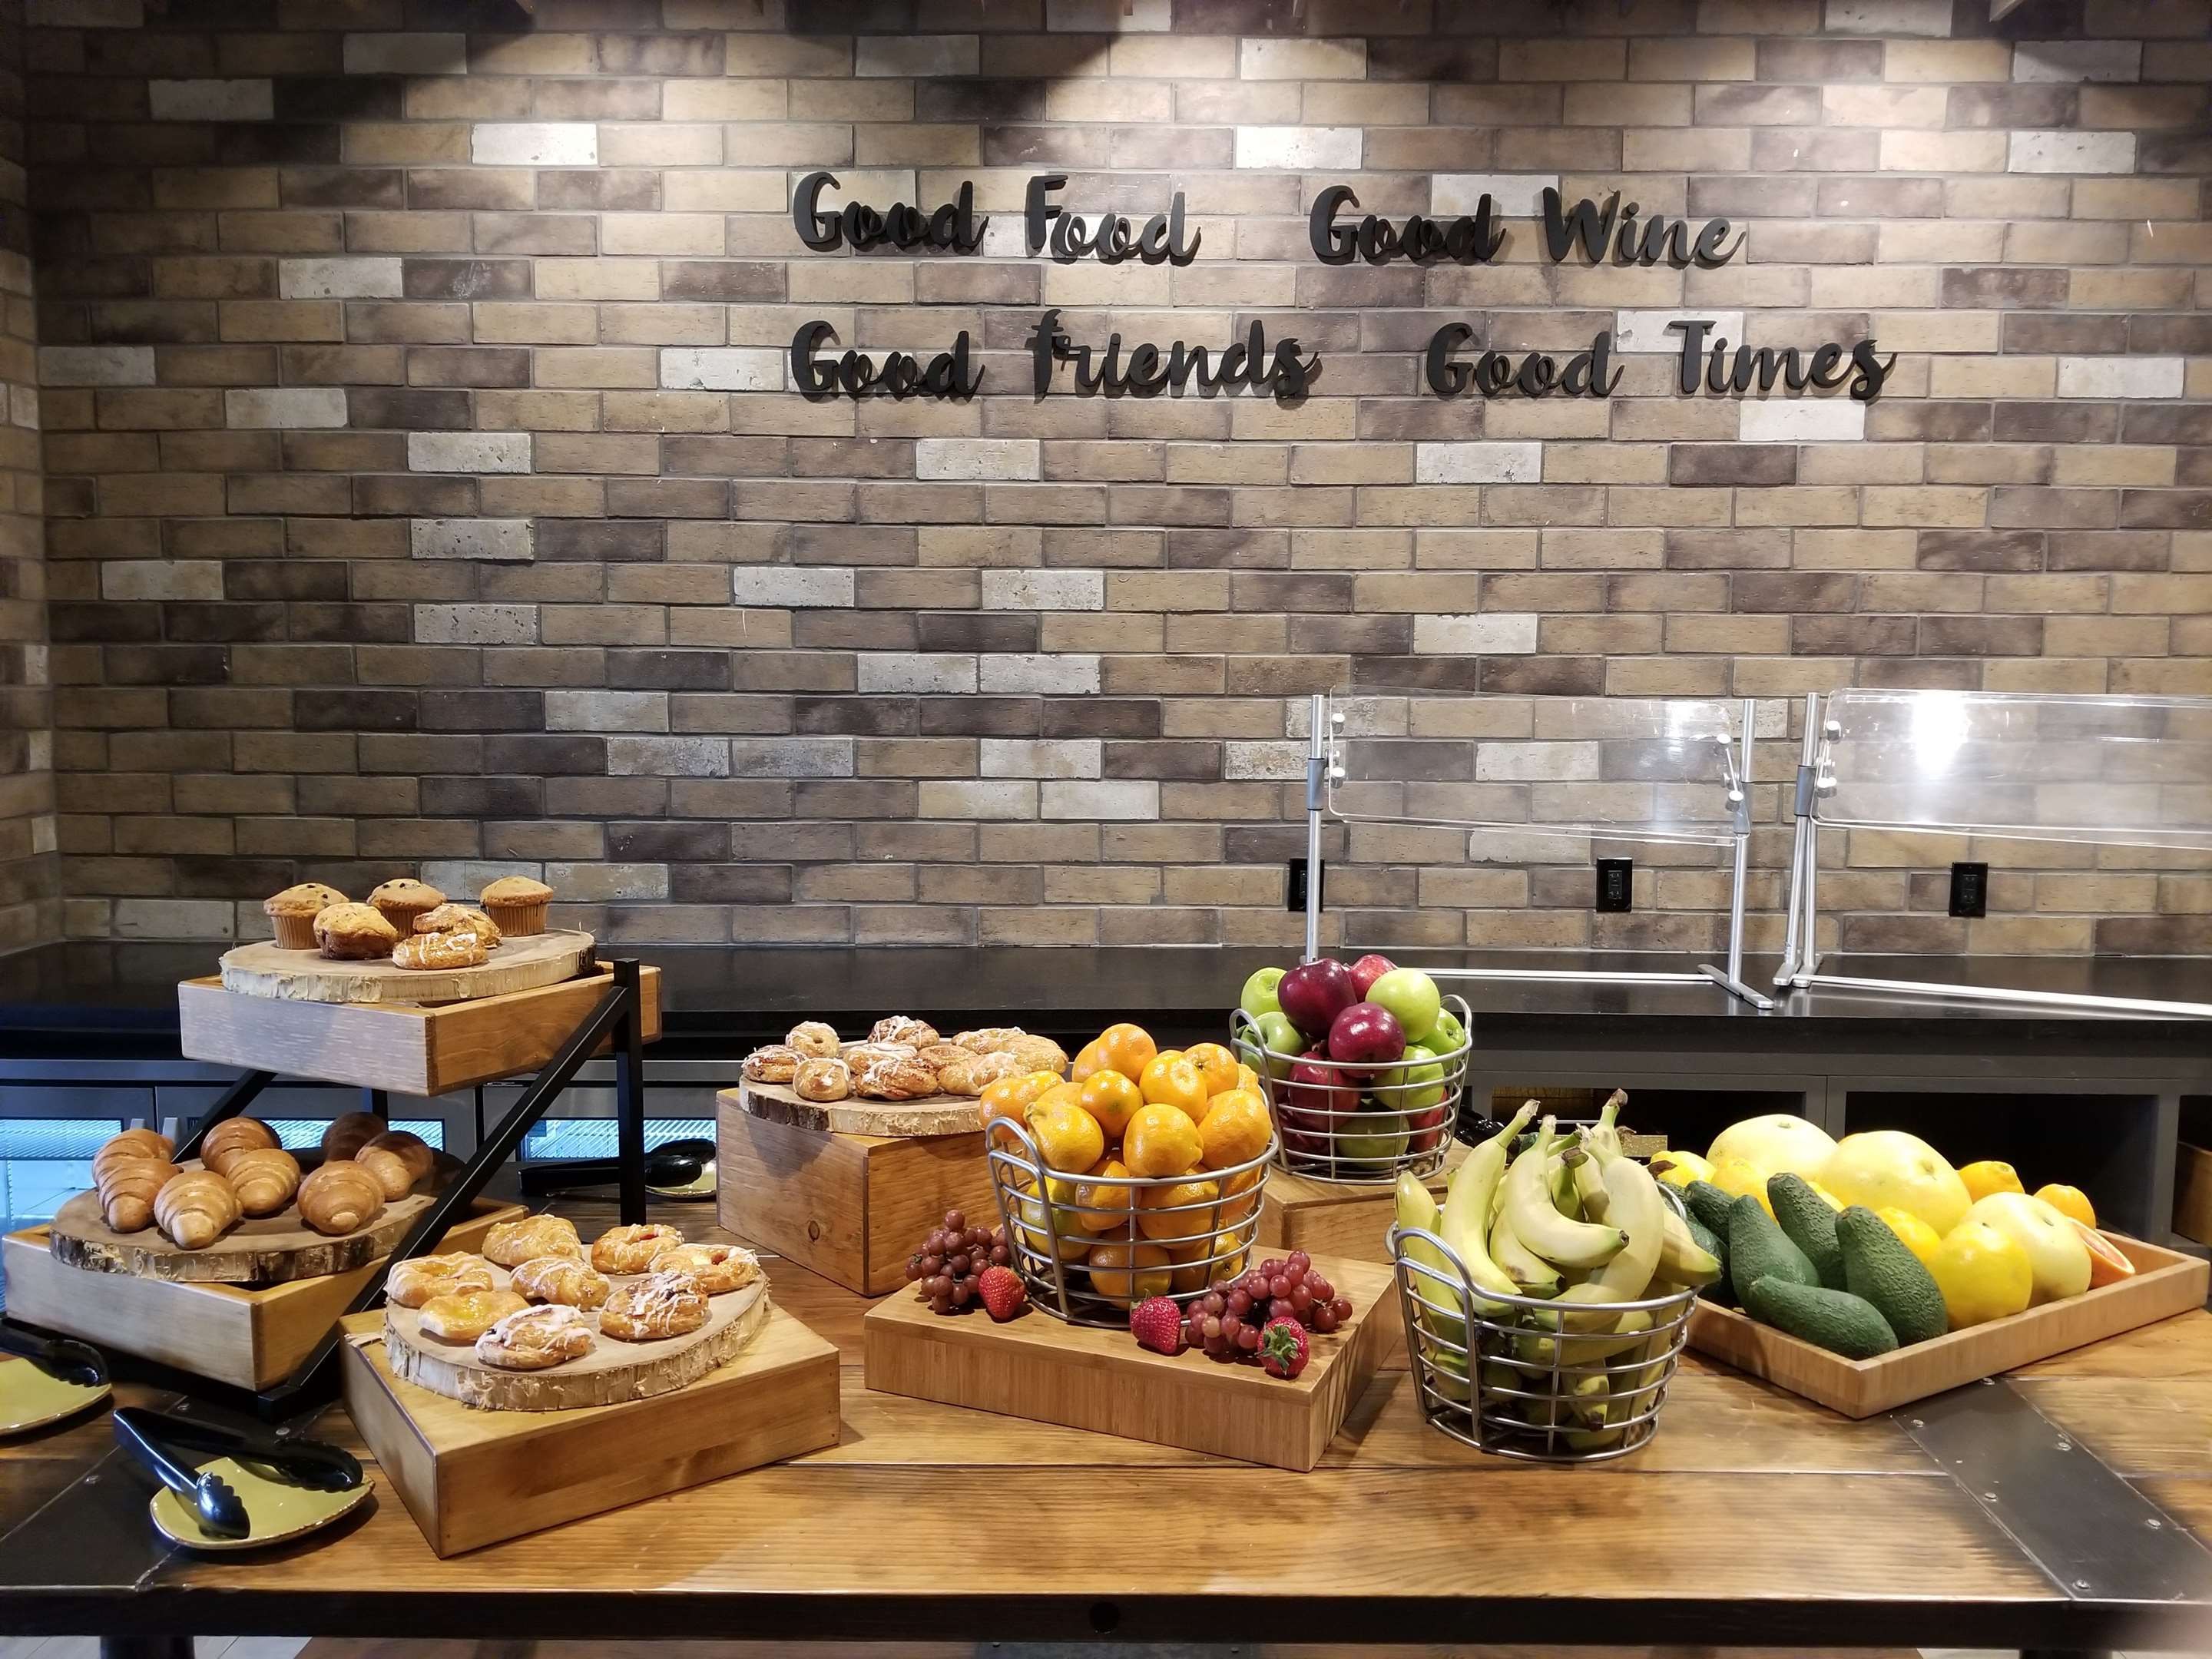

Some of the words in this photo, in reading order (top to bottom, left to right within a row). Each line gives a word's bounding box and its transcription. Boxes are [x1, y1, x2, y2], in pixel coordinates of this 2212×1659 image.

[792, 171, 989, 250] Good
[1026, 174, 1202, 262] Food
[1309, 184, 1507, 263] Good
[1542, 185, 1747, 267] Wine
[790, 320, 986, 399] Good
[1426, 322, 1625, 398] Good
[1667, 319, 1897, 402] Times
